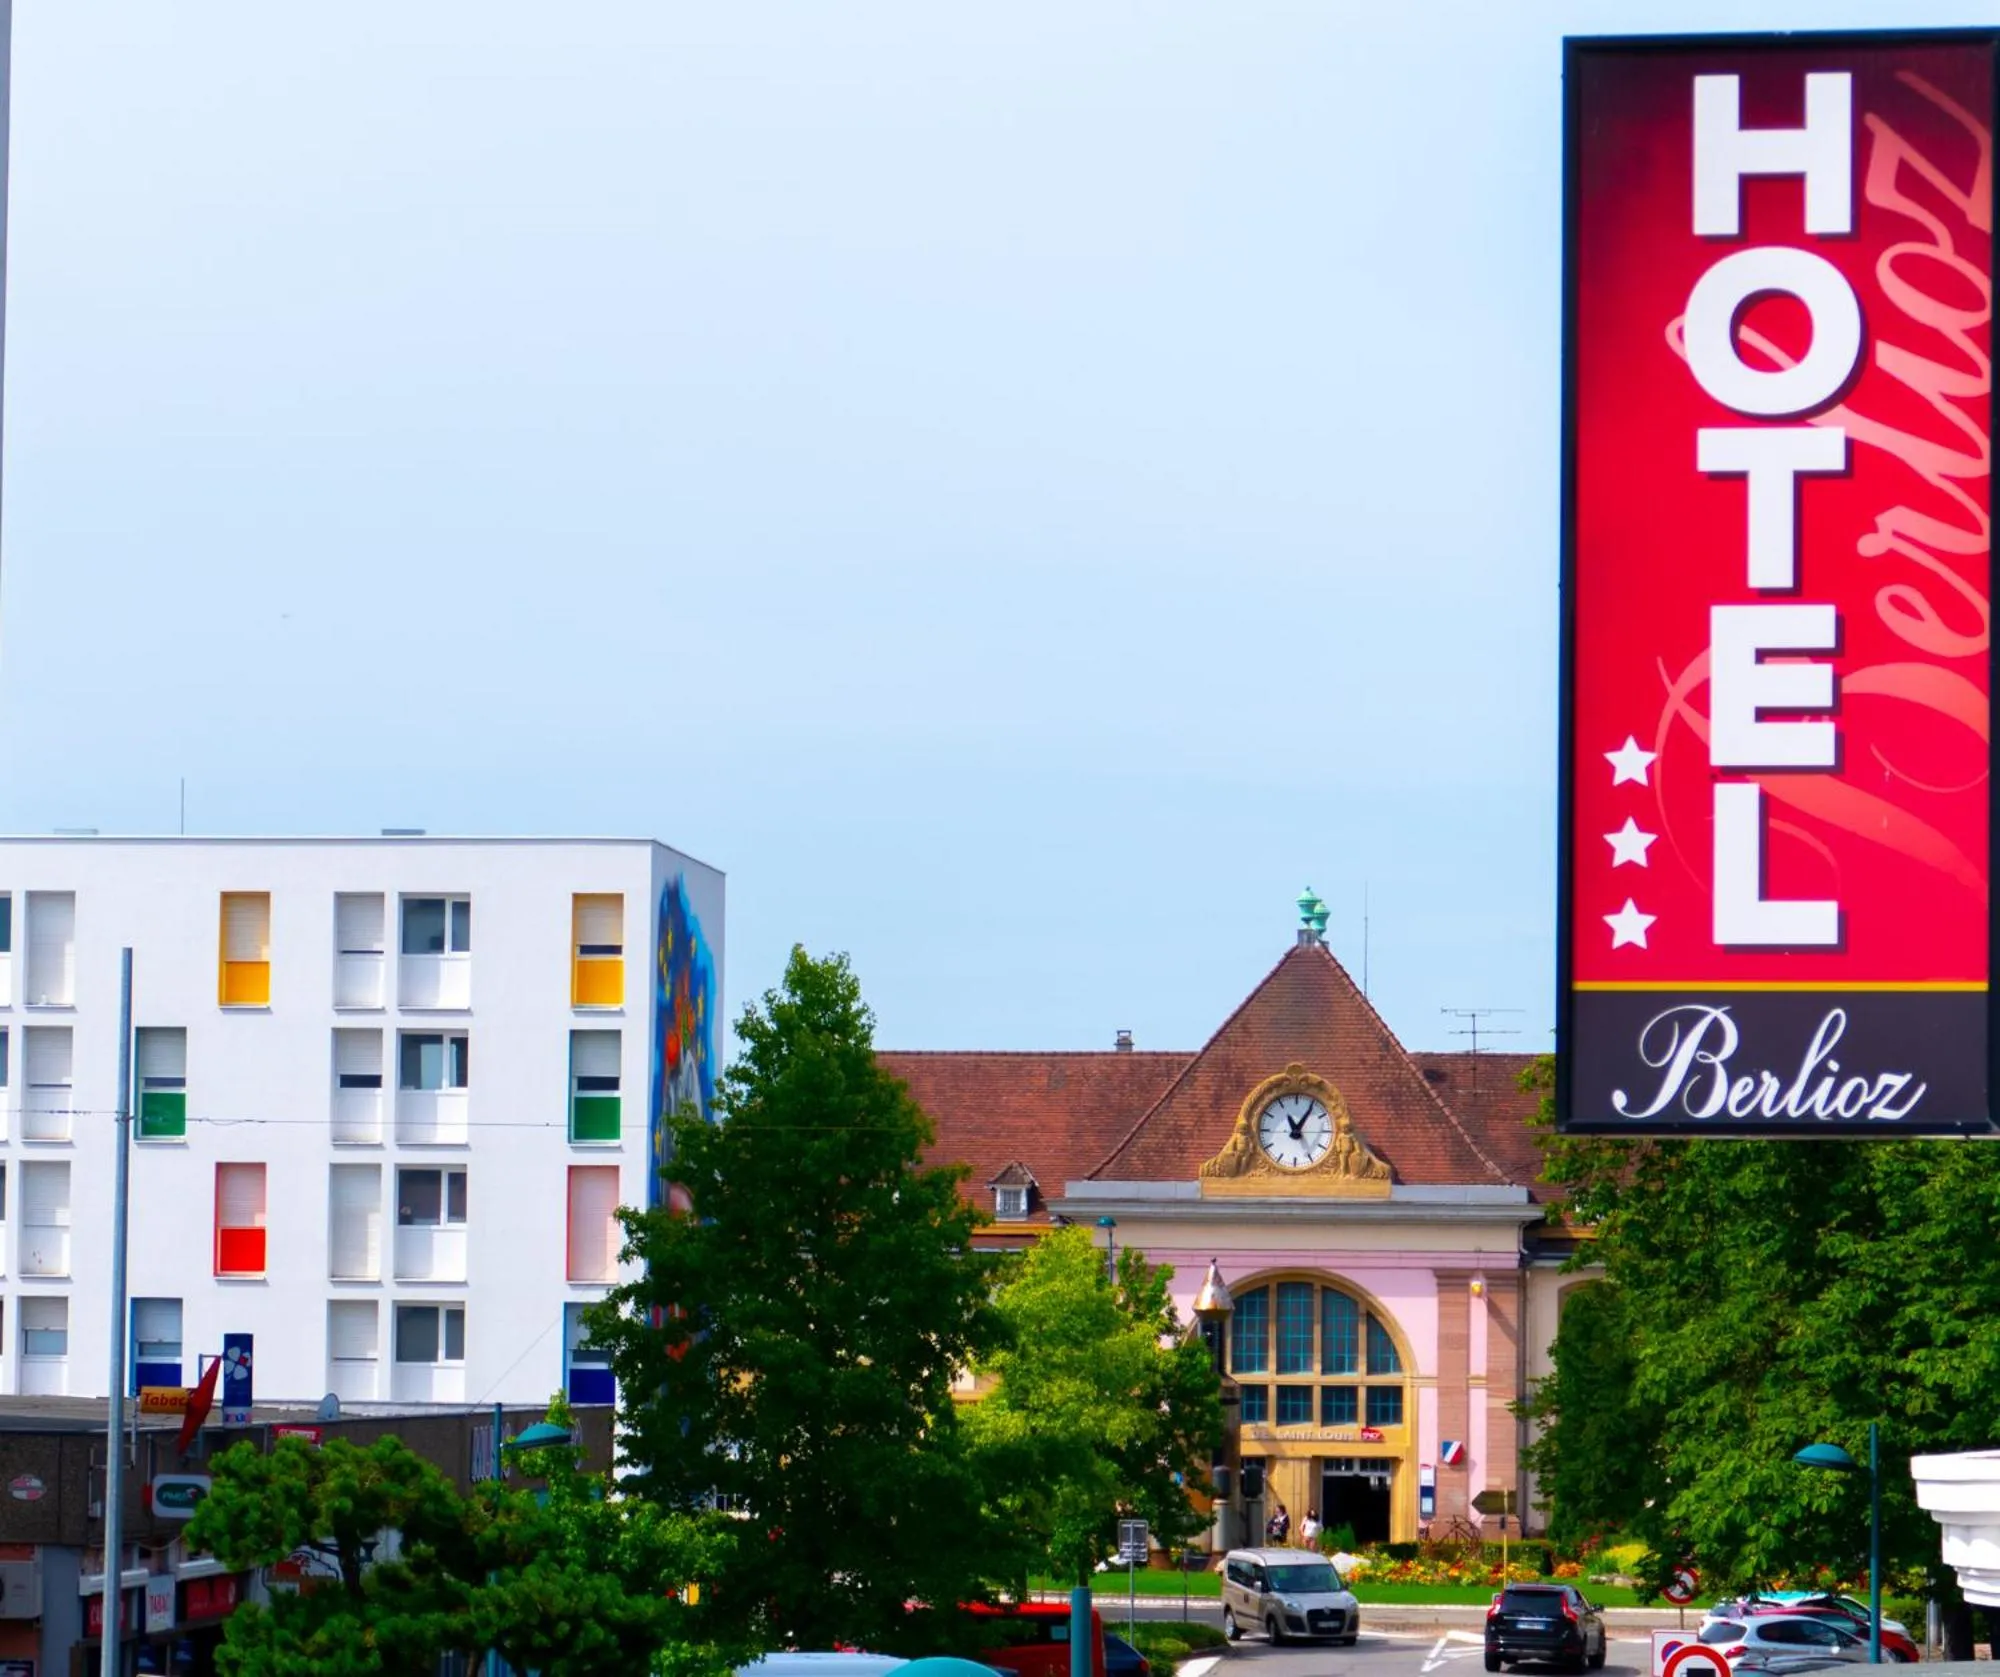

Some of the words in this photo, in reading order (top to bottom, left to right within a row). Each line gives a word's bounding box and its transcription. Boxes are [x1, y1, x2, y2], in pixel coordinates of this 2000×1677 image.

[1684, 72, 1862, 946] HOTEL
[1611, 1004, 1927, 1121] Berlioz
[143, 1392, 187, 1406] Tabac
